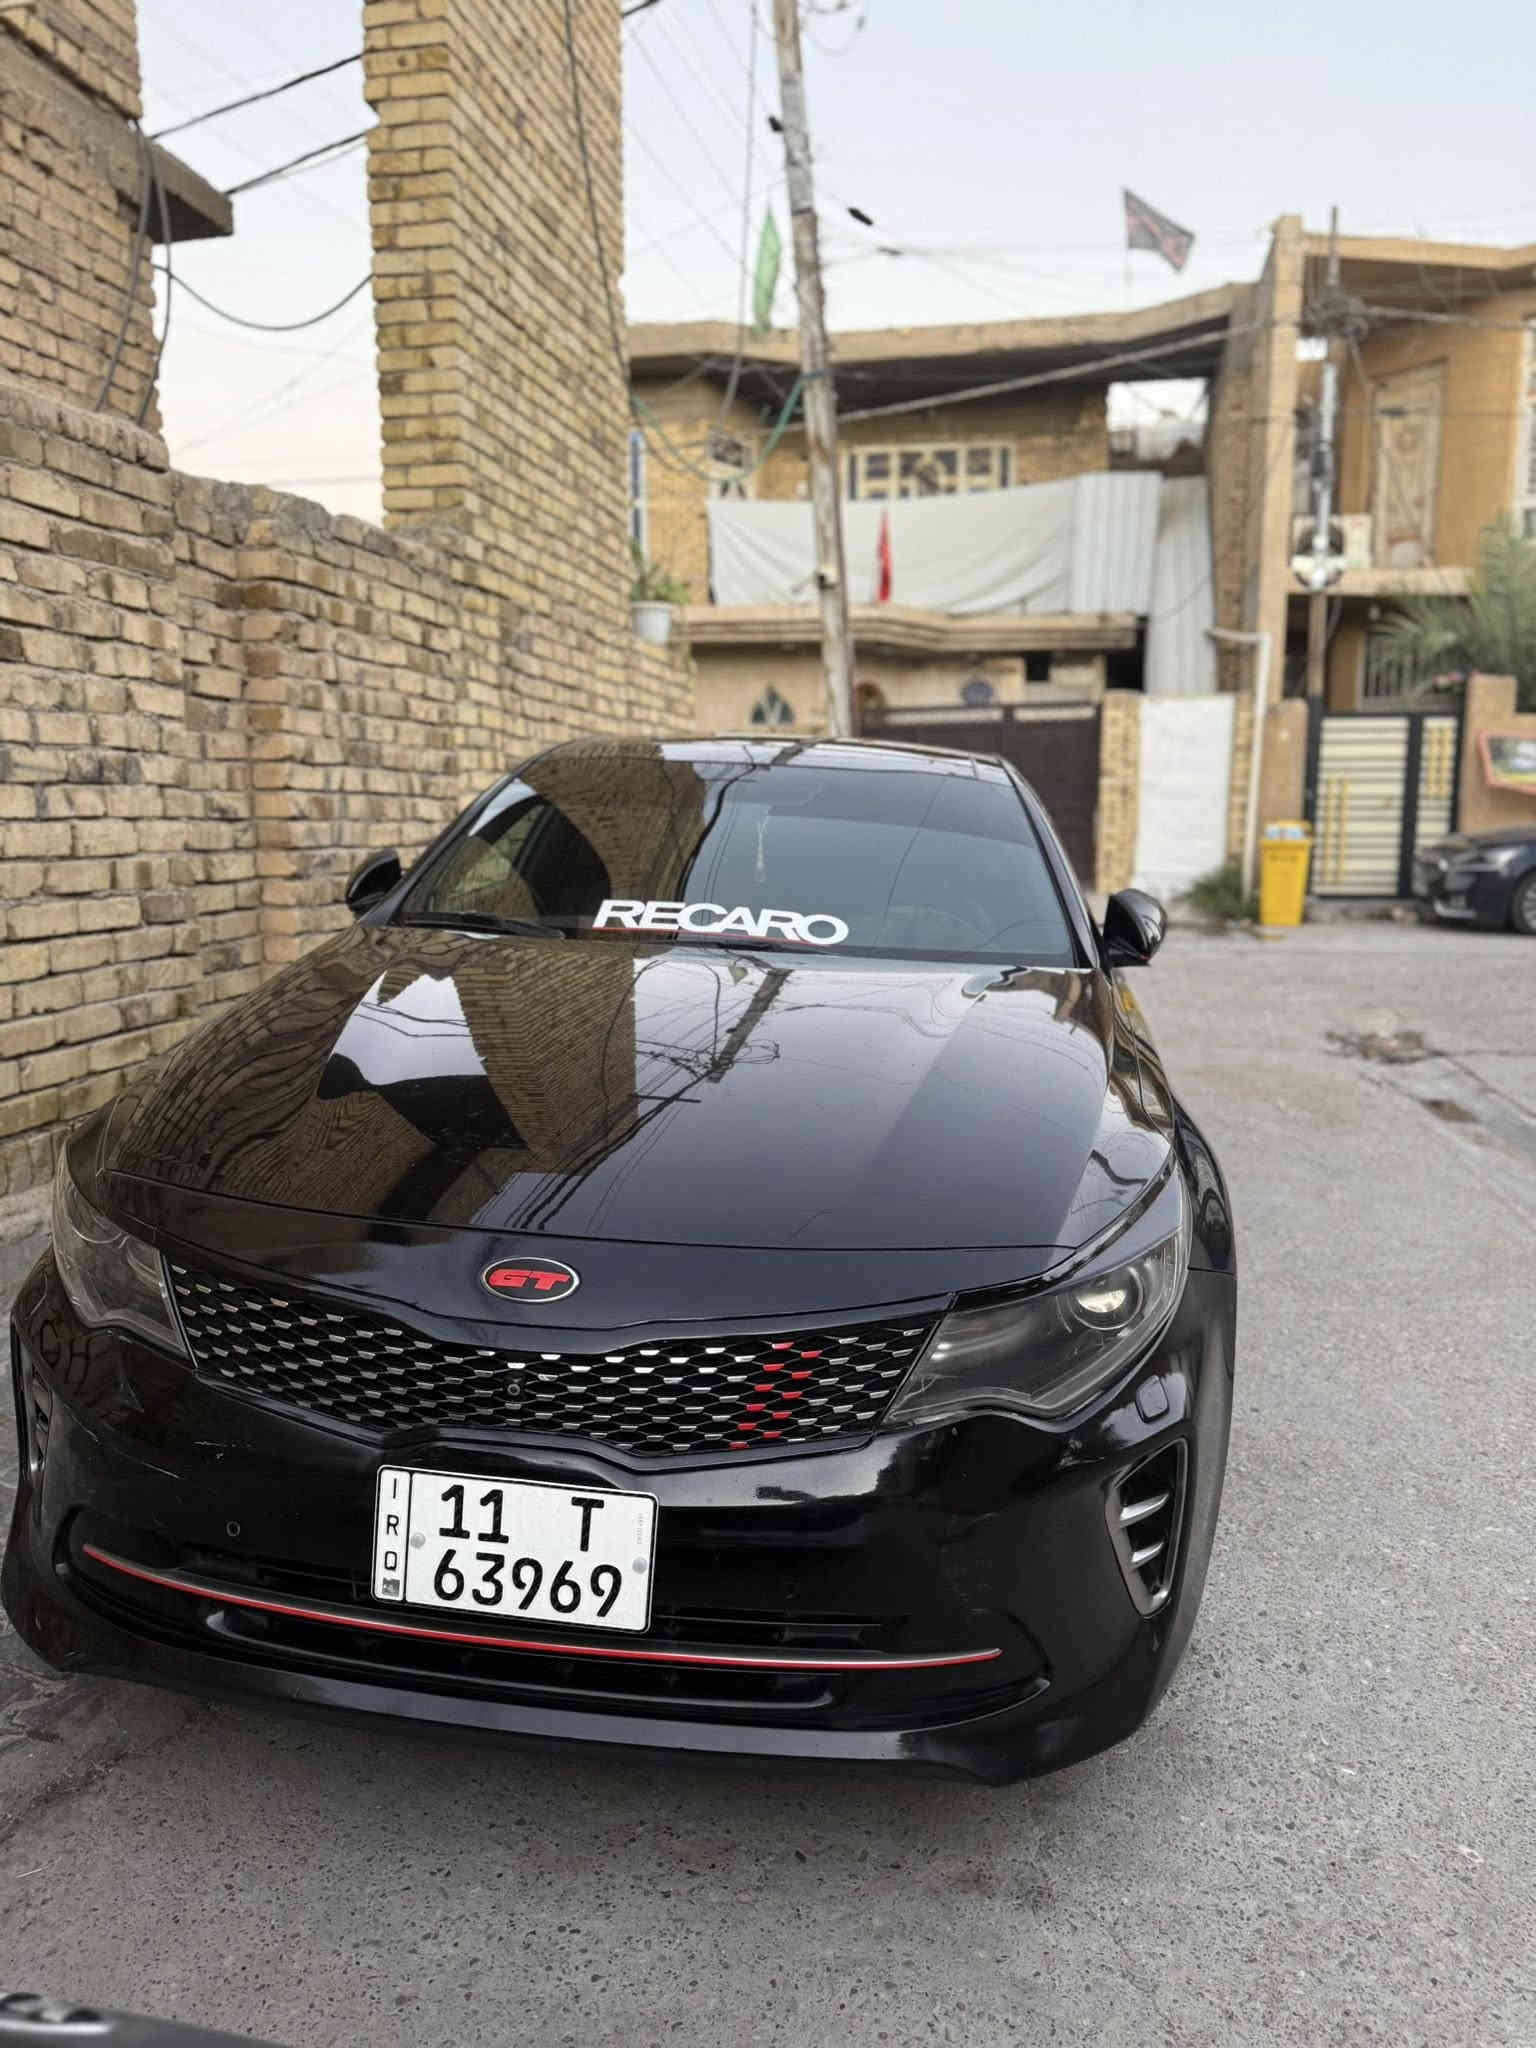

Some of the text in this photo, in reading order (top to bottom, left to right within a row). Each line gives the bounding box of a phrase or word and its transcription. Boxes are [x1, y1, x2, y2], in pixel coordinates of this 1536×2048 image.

[592, 899, 849, 945] RECARO
[488, 1268, 571, 1291] GT
[438, 1484, 509, 1544] 11
[571, 1496, 605, 1552] T
[433, 1549, 623, 1618] 63969
